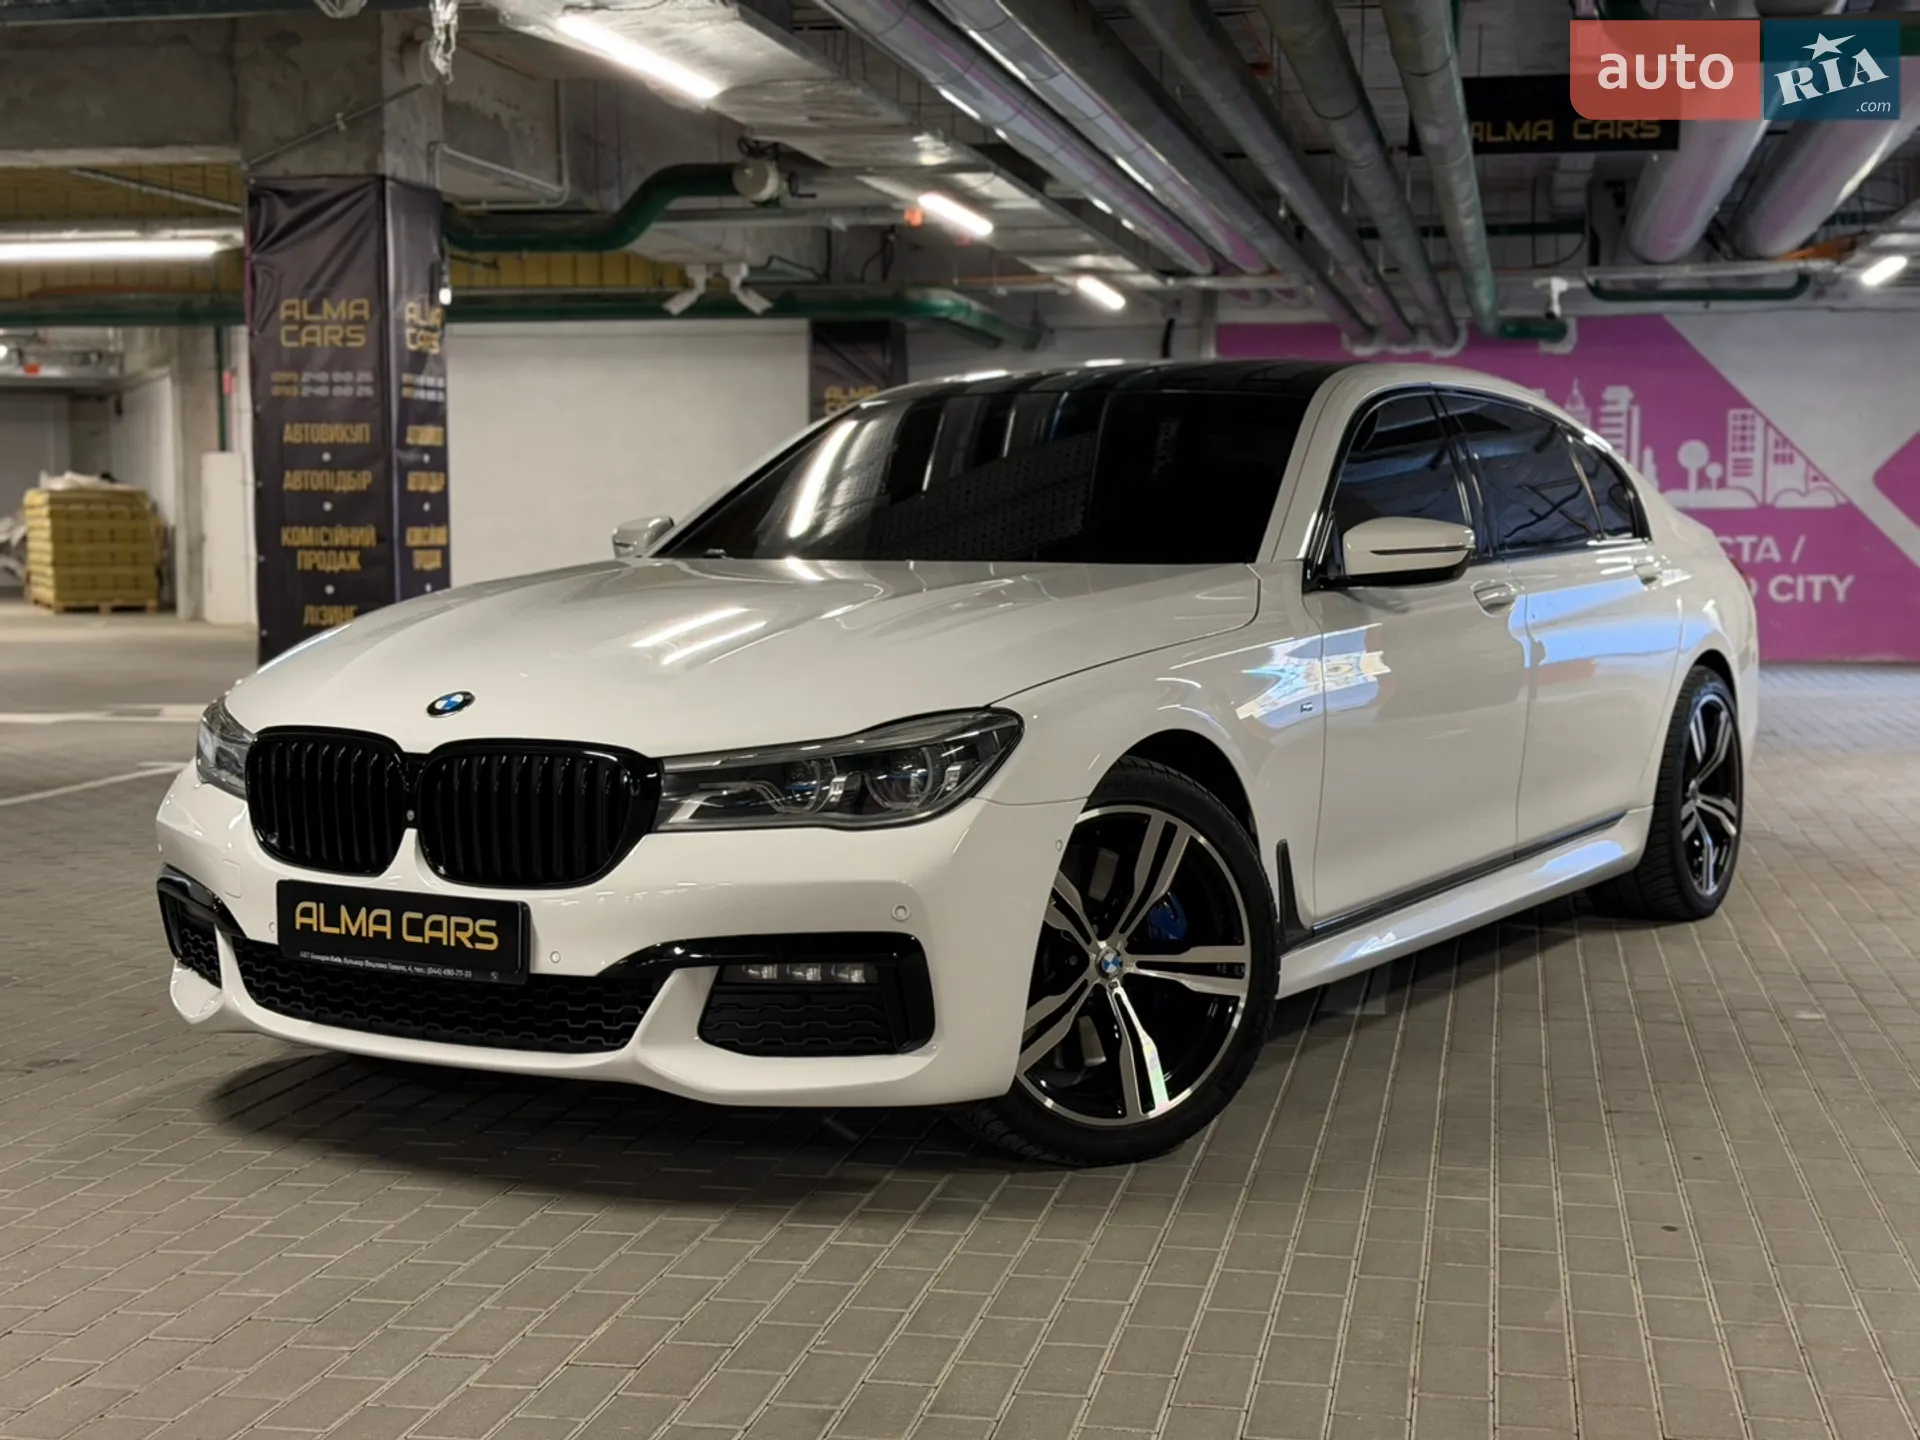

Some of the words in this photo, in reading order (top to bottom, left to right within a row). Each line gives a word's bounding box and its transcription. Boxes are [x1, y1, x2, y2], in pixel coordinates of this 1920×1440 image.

[1470, 120, 1554, 143] ALMA
[1572, 118, 1661, 141] CARS
[280, 298, 370, 321] ALMA
[281, 324, 367, 348] CARS
[283, 422, 371, 444] АВТОВИКУП
[283, 469, 373, 493] АВТОПІДБІР
[281, 523, 377, 547] КОМІСІЙНИЙ
[297, 549, 361, 573] ПРОДАЖ
[1768, 574, 1855, 603] CITY
[295, 901, 392, 940] ALMA
[402, 911, 499, 951] CARS
